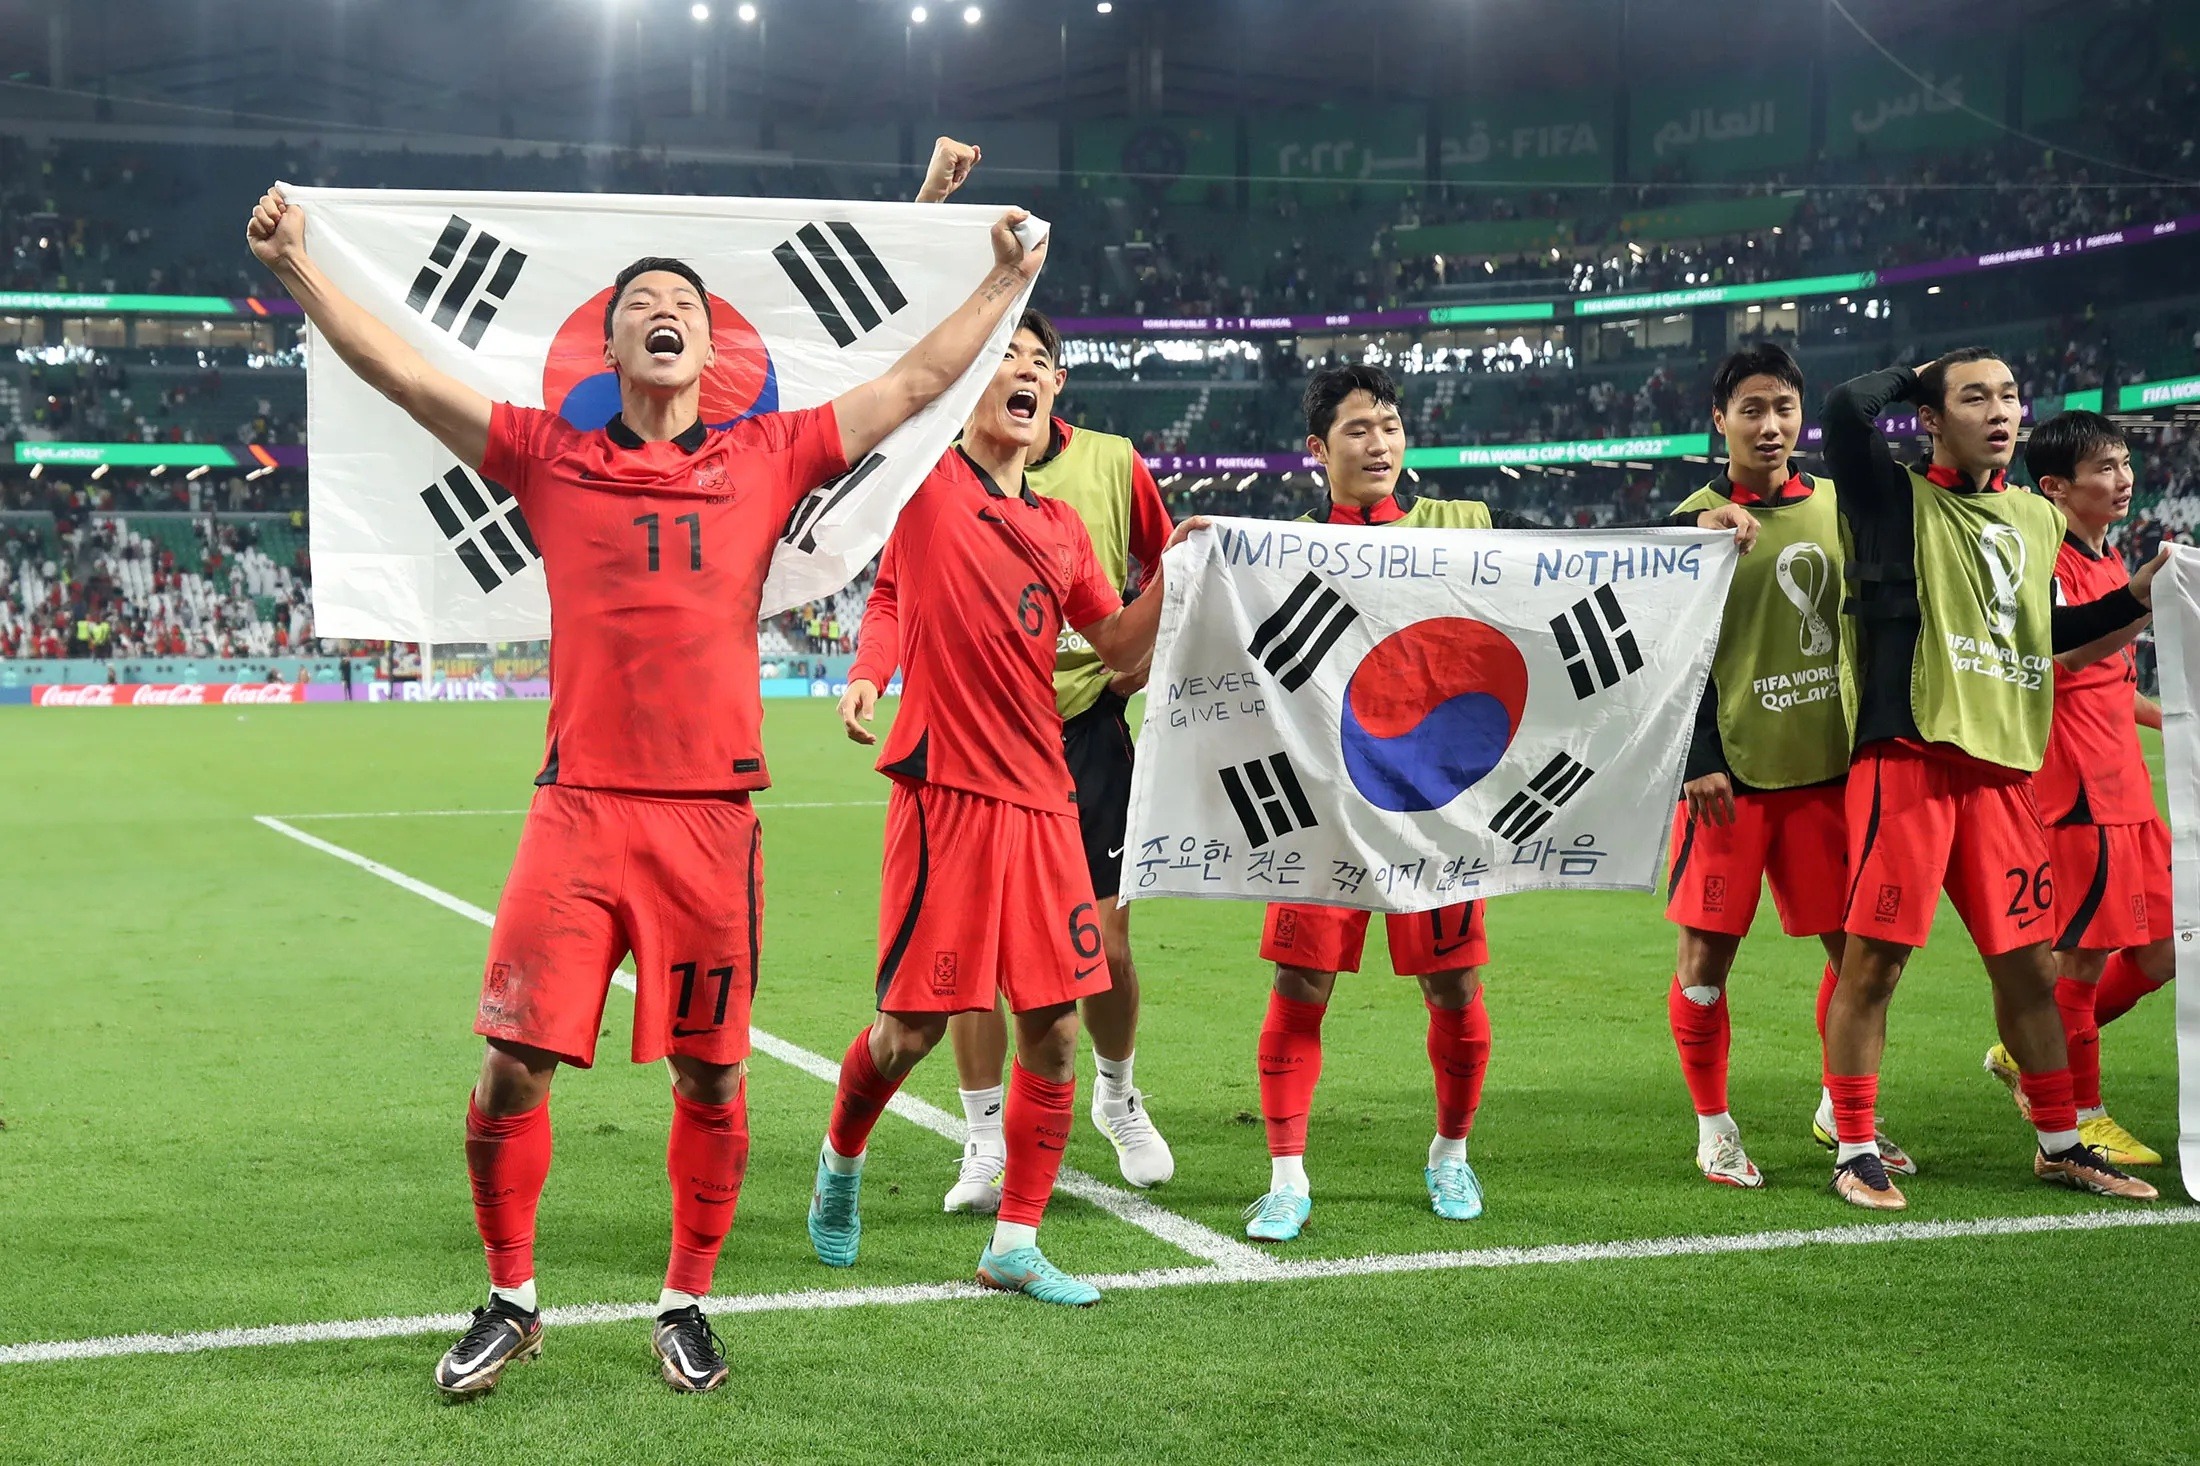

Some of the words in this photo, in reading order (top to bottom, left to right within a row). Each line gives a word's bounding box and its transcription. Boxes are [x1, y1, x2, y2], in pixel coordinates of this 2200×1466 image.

[1511, 121, 1598, 159] FIFA
[1653, 100, 1775, 157] العالم
[2052, 241, 2061, 255] 2
[1215, 317, 1224, 330] 2
[1250, 317, 1292, 329] PORTUGAL
[2142, 385, 2171, 405] FIFA
[1885, 418, 1895, 433] 2
[1172, 456, 1182, 469] 2
[1199, 457, 1206, 469] 1
[1216, 457, 1267, 469] PORTUGAL
[1459, 449, 1491, 464] FIFA
[1491, 445, 1539, 462] WORLD
[1541, 445, 1565, 460] CUP
[705, 494, 737, 505] KOREA
[633, 511, 703, 572] 11
[1222, 527, 1449, 580] IMPOSSIBLE
[1471, 549, 1503, 586] IS
[1533, 543, 1703, 587] NOTHING
[1017, 582, 1051, 637] 6
[2021, 654, 2051, 672] CUP
[1168, 671, 1261, 705] NEVER
[1753, 673, 1792, 694] FIFA
[1792, 663, 1840, 686] WORL
[1170, 701, 1231, 728] GIVE
[1240, 699, 1266, 717] UP
[1136, 835, 1233, 888] 중요한
[1247, 850, 1306, 884] 것은
[1511, 834, 1608, 876] 마음
[2005, 860, 2053, 917] 26
[1703, 904, 1723, 913] KOREA
[1874, 915, 1896, 925] KOREA
[1068, 902, 1102, 959] 6
[670, 961, 734, 1026] 11
[933, 986, 956, 996] KOREA
